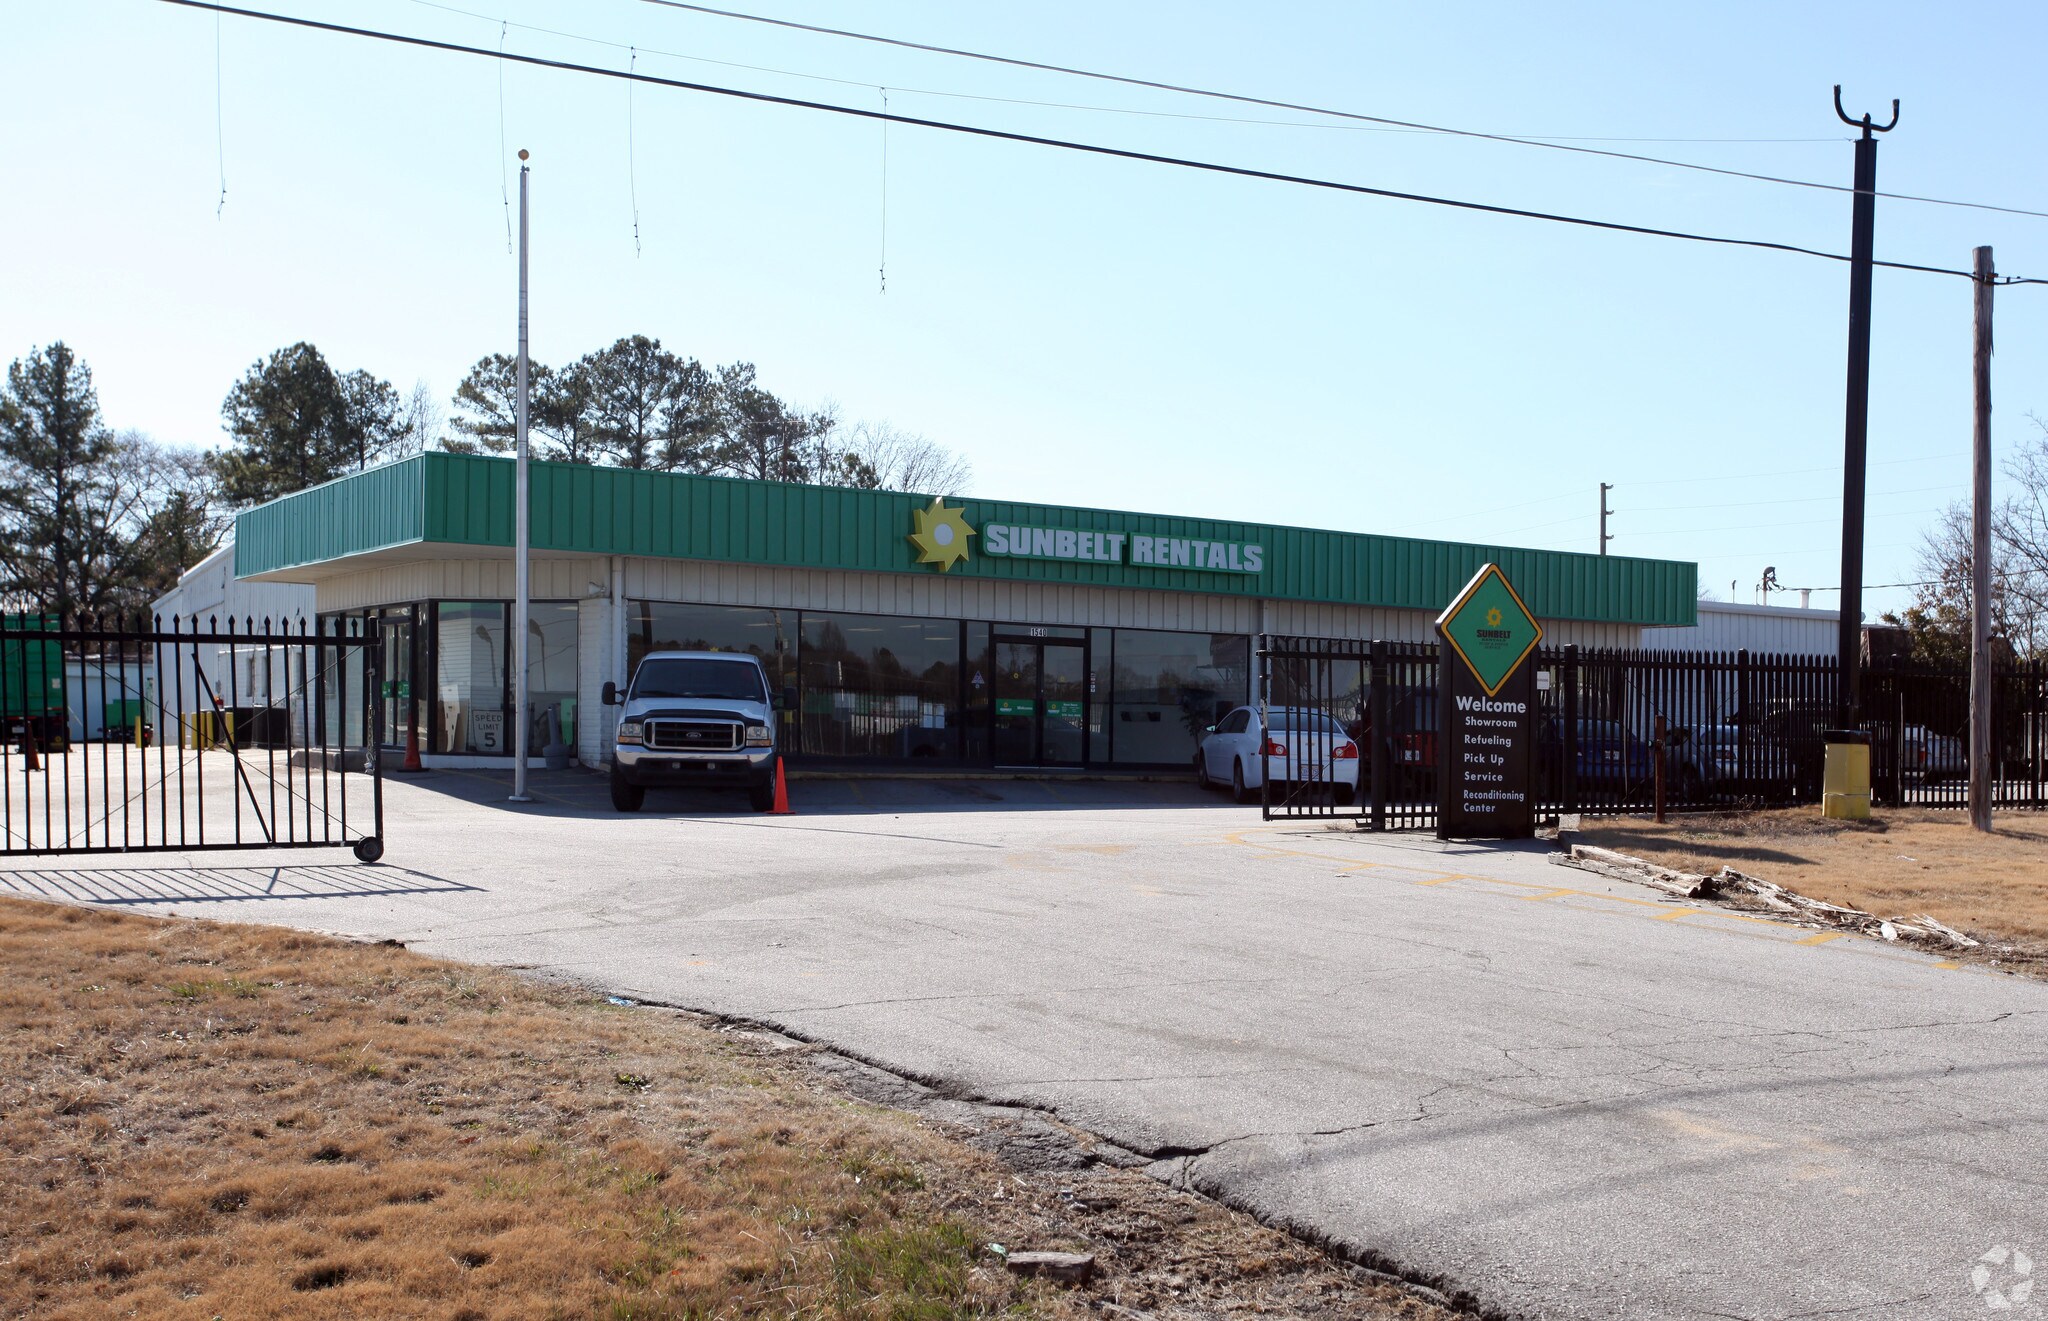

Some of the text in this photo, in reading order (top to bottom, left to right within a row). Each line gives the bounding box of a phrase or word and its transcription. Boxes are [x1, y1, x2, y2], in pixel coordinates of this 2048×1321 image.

[985, 523, 1264, 573] SUNBELT RENTALS
[1476, 629, 1511, 639] SUNBELT
[1455, 695, 1527, 714] Welcome
[474, 714, 503, 722] SPEED
[1465, 715, 1517, 728] Showroom
[484, 732, 497, 748] 5
[1464, 734, 1512, 748] Refueling
[1464, 753, 1504, 766] Pick Up
[1464, 771, 1503, 782] Service
[1463, 789, 1525, 802] Reconditioning
[1463, 802, 1496, 812] Center
